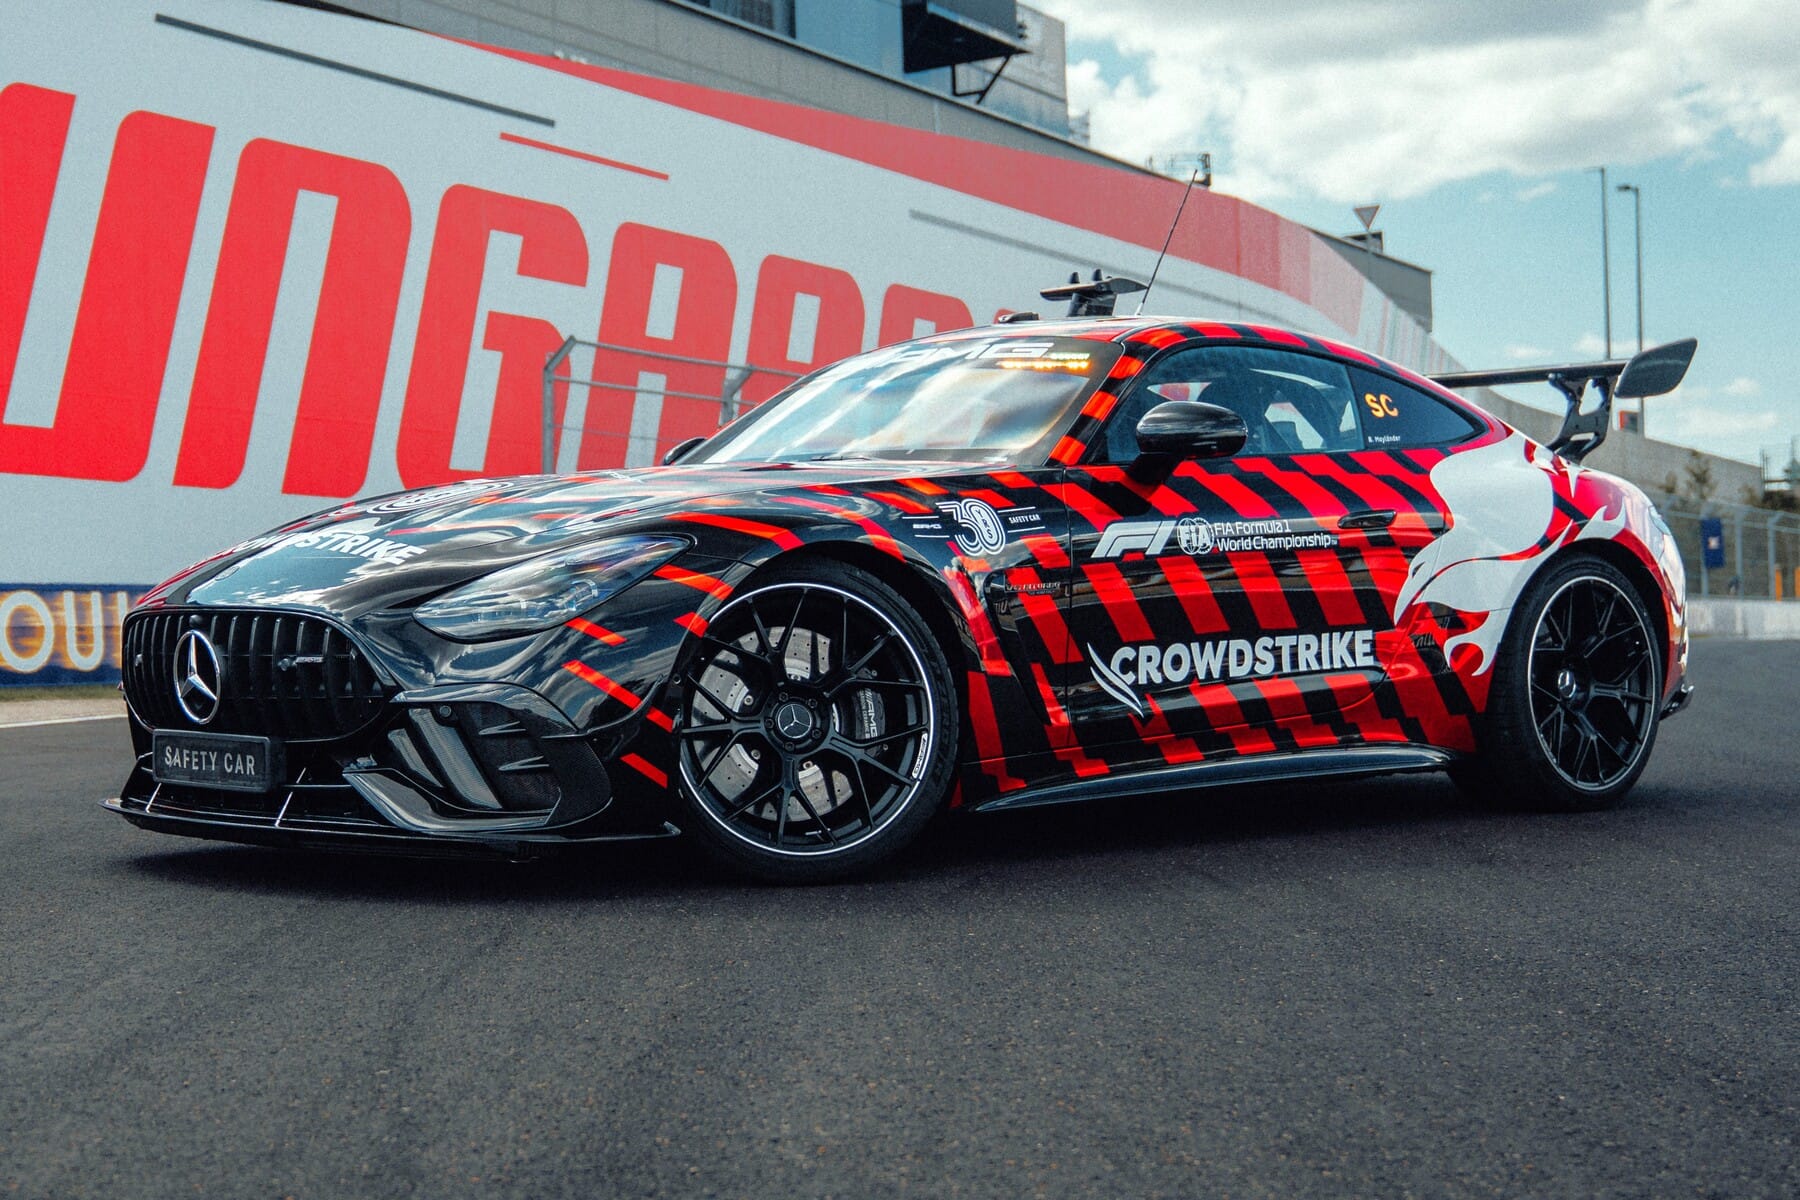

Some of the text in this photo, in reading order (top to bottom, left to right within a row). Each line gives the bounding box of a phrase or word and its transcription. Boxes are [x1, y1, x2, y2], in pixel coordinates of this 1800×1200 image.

[1365, 393, 1399, 418] SC
[935, 498, 1006, 556] 30
[1008, 514, 1041, 524] SAFETY CAR
[1214, 520, 1291, 536] FIA Formula 1
[1216, 533, 1331, 552] World Championship
[1110, 629, 1374, 686] CROWDSTRIKE
[165, 745, 255, 776] SAFETY CAR
